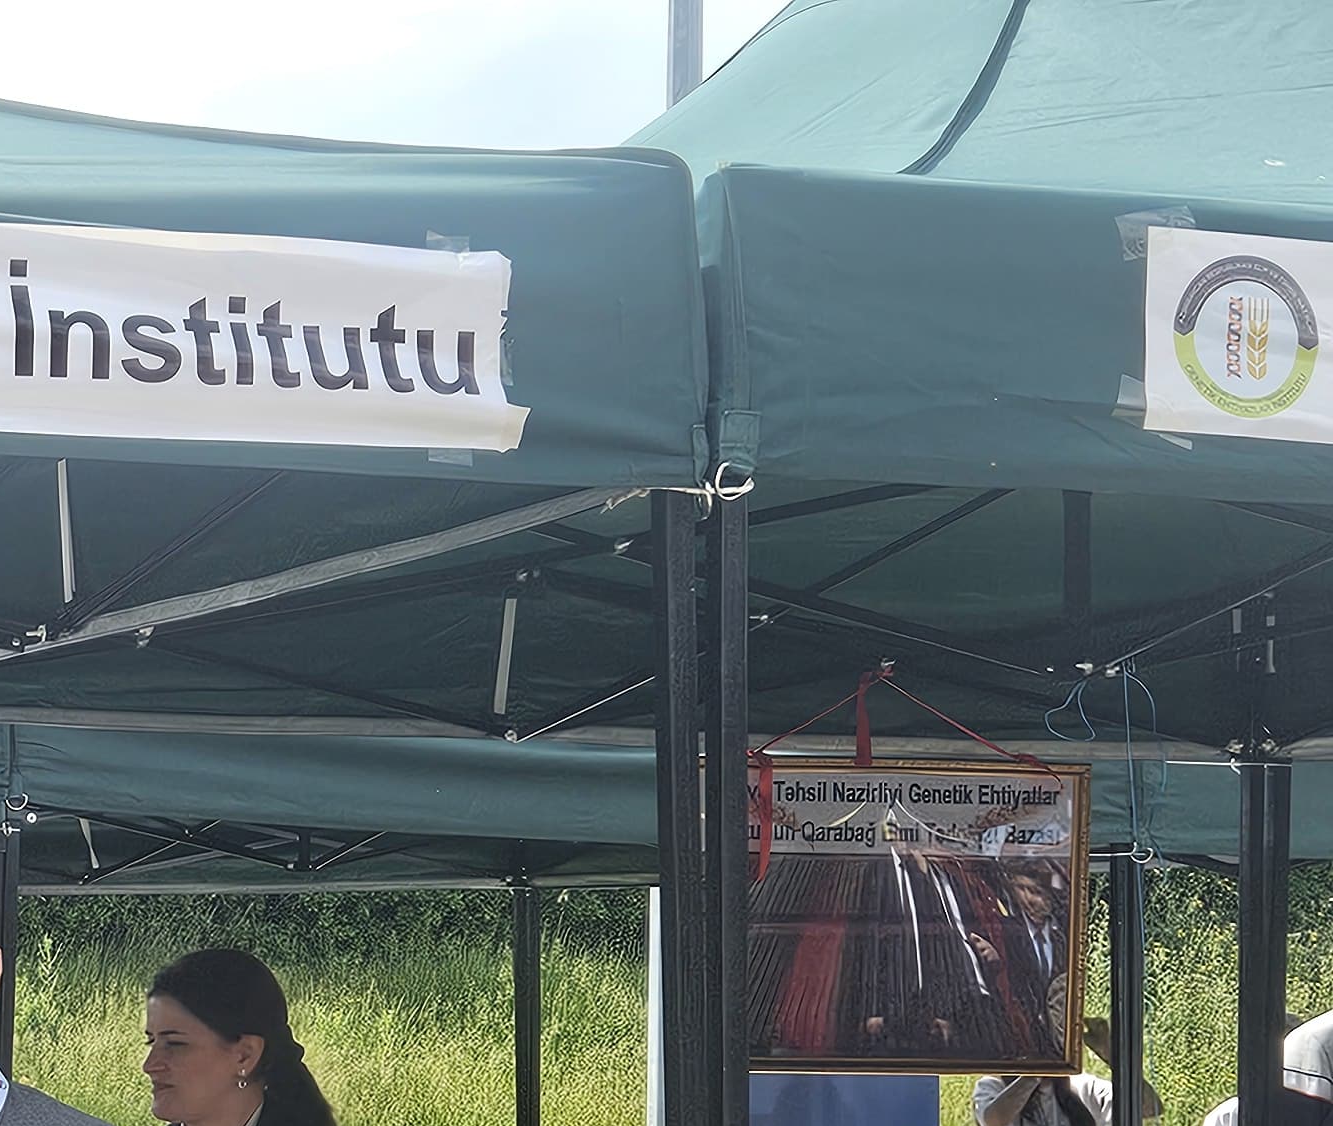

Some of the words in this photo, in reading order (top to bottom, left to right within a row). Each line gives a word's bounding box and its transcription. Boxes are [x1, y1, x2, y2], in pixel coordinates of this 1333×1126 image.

[10, 257, 479, 397] İnstitutu
[772, 781, 827, 802] Təhsil
[909, 782, 973, 804] Genetik
[802, 820, 876, 847] Qarabağ
